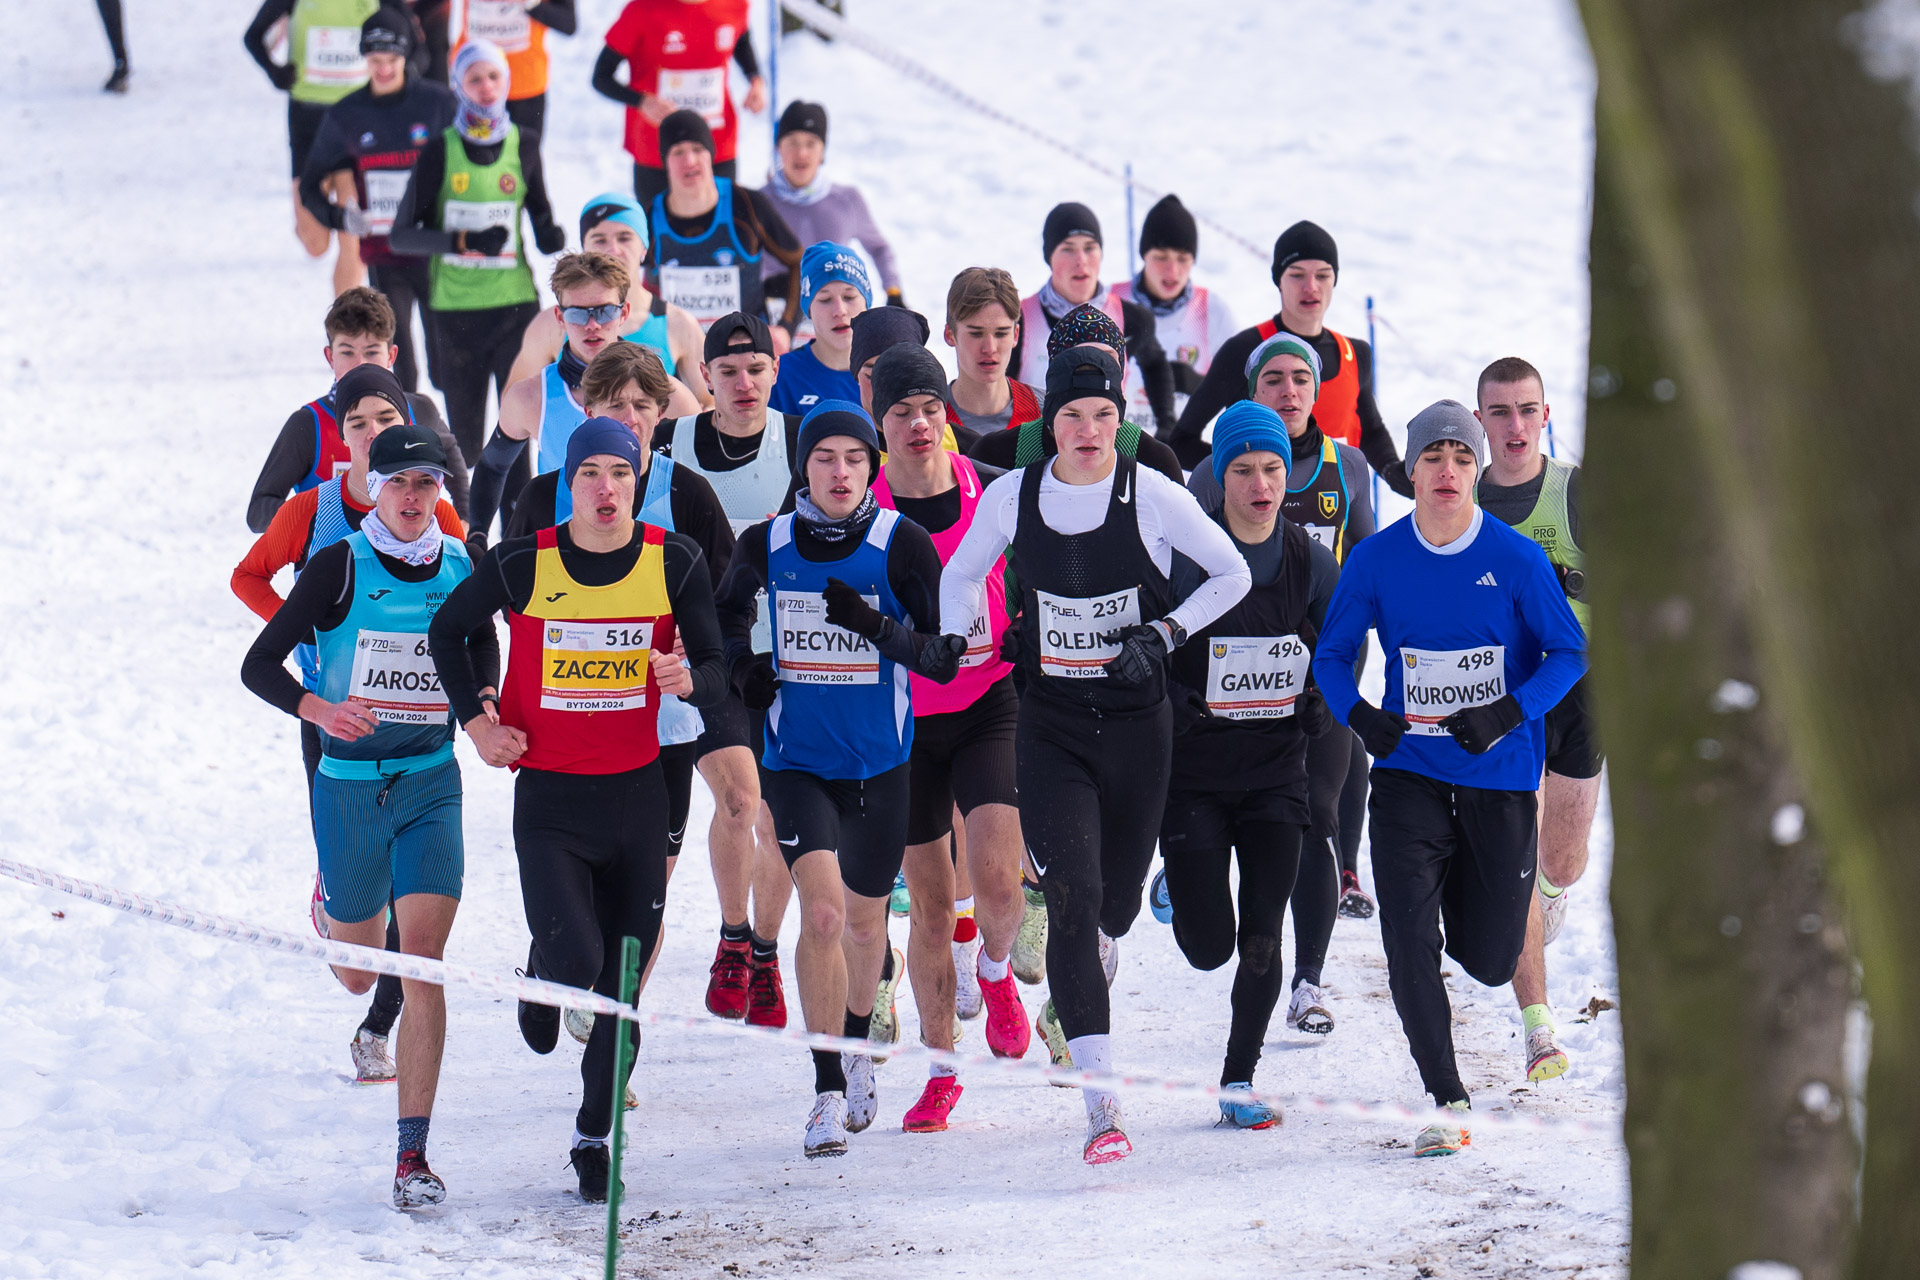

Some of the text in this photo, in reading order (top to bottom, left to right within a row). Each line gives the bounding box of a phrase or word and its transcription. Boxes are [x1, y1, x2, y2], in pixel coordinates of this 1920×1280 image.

[703, 273, 732, 287] 528
[1441, 425, 1459, 433] 4F
[1533, 528, 1557, 539] PRO
[788, 599, 804, 609] 770
[1051, 604, 1082, 617] FUEL
[1092, 594, 1129, 619] 237
[372, 639, 389, 649] 770
[605, 629, 643, 647] 516
[783, 629, 871, 653] PECYNA
[414, 639, 433, 657] 6
[1268, 640, 1302, 658] 496
[1457, 650, 1494, 671] 498
[551, 658, 640, 680] ZACZYK
[1066, 668, 1098, 676] BYTOM
[362, 668, 441, 692] JAROSZ
[796, 673, 854, 682] BYTOM 2024
[1221, 669, 1294, 692] GAWEŁ
[1406, 676, 1502, 706] KUROWSKI
[566, 700, 624, 709] BYTOM 2024
[371, 710, 427, 721] BYTOM 2024
[1229, 709, 1284, 718] BYTOM 2024
